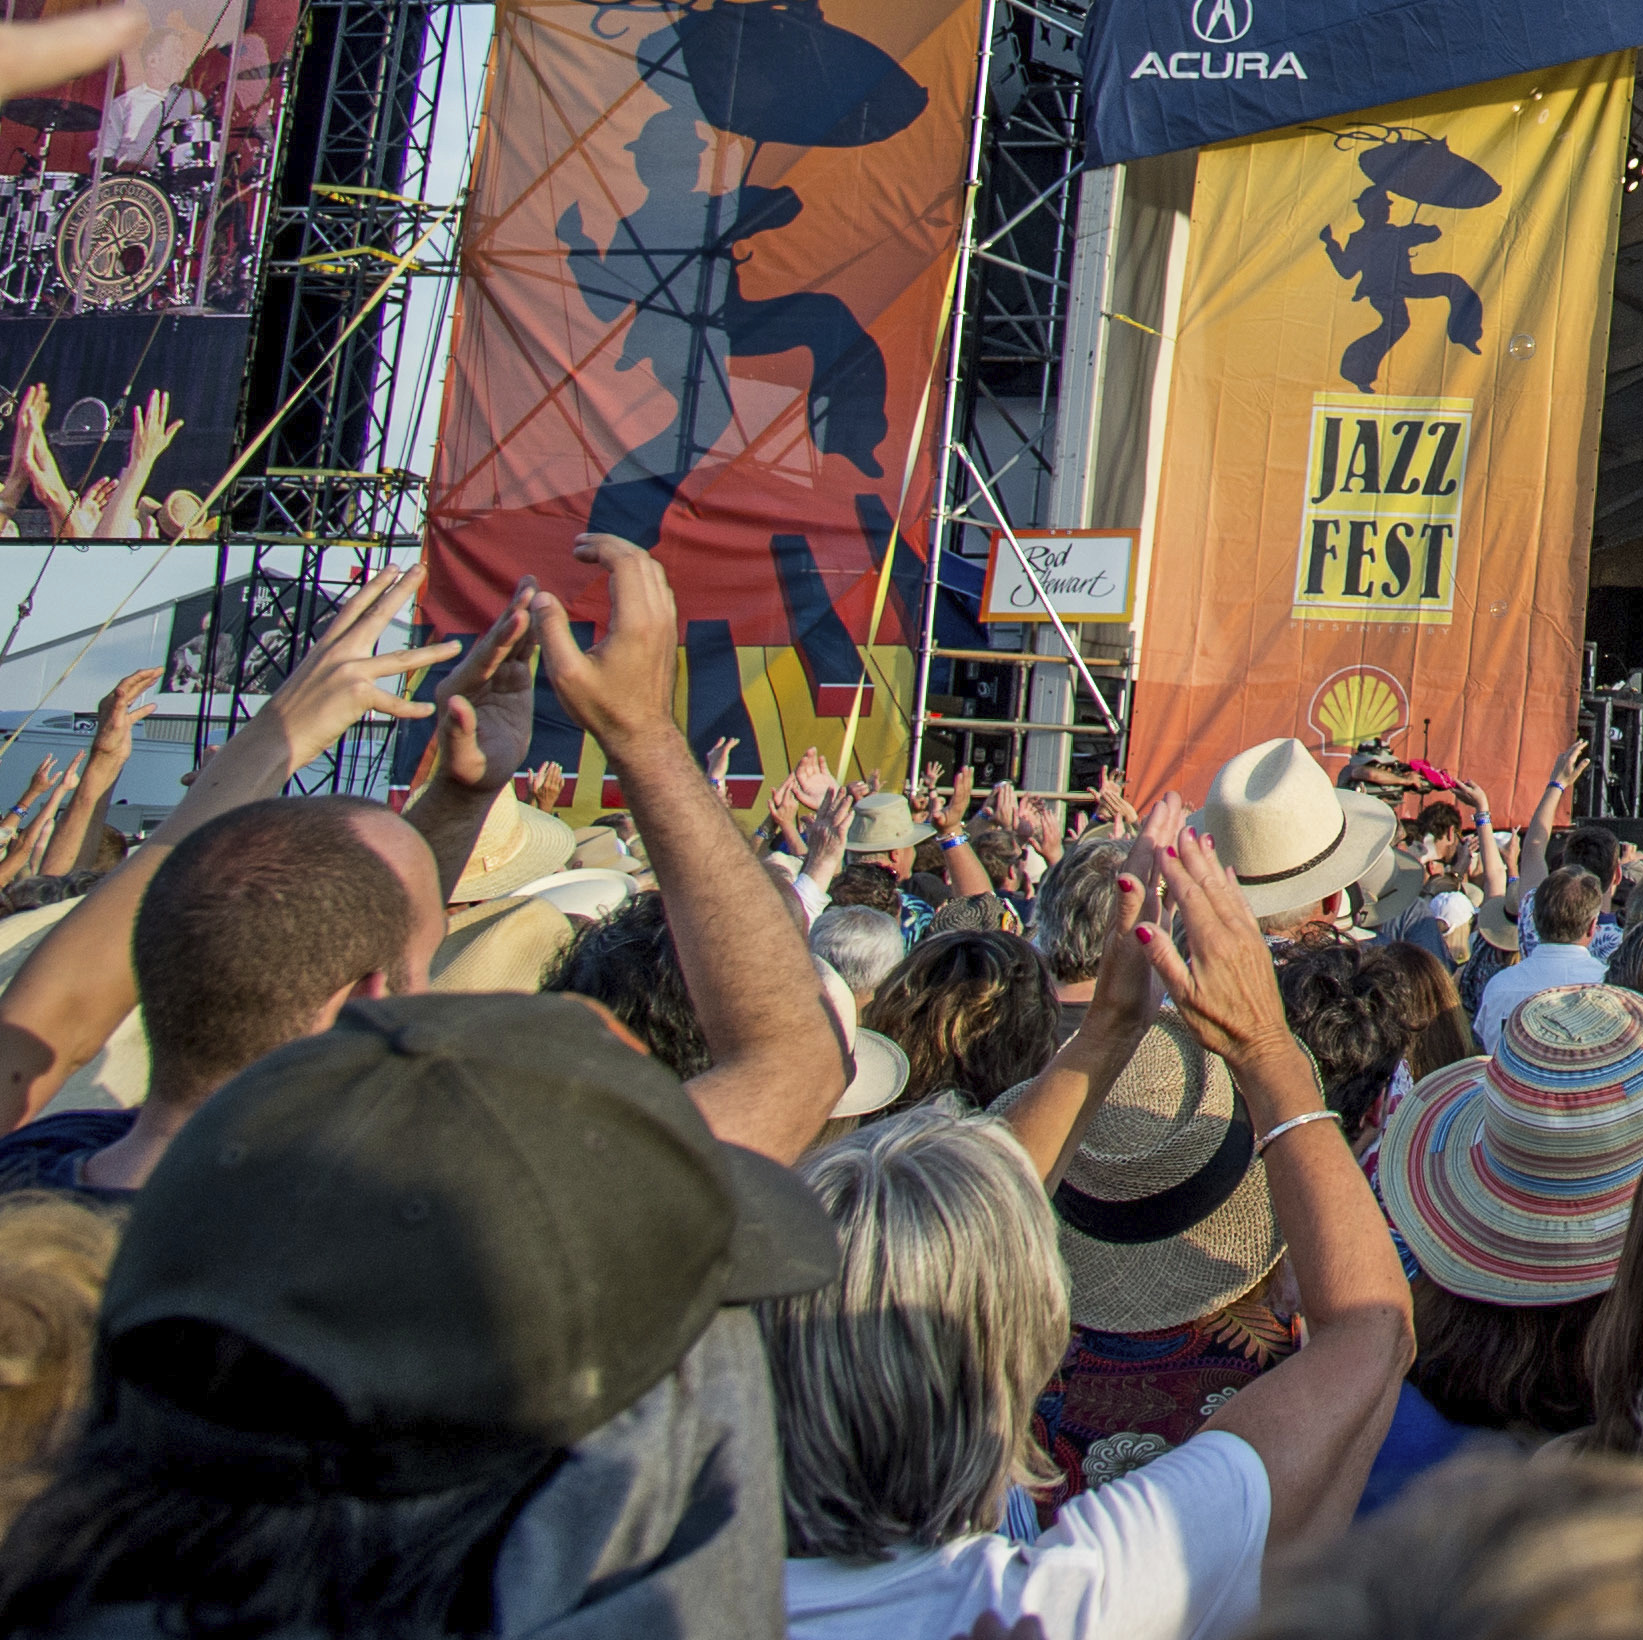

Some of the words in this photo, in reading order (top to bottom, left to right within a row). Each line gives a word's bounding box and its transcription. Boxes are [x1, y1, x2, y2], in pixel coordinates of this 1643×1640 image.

[1130, 51, 1308, 79] ACURA
[1311, 417, 1462, 504] JAZZ
[1022, 543, 1073, 573] Rod
[1304, 519, 1453, 599] FEST
[1290, 622, 1411, 633] PRESENTED
